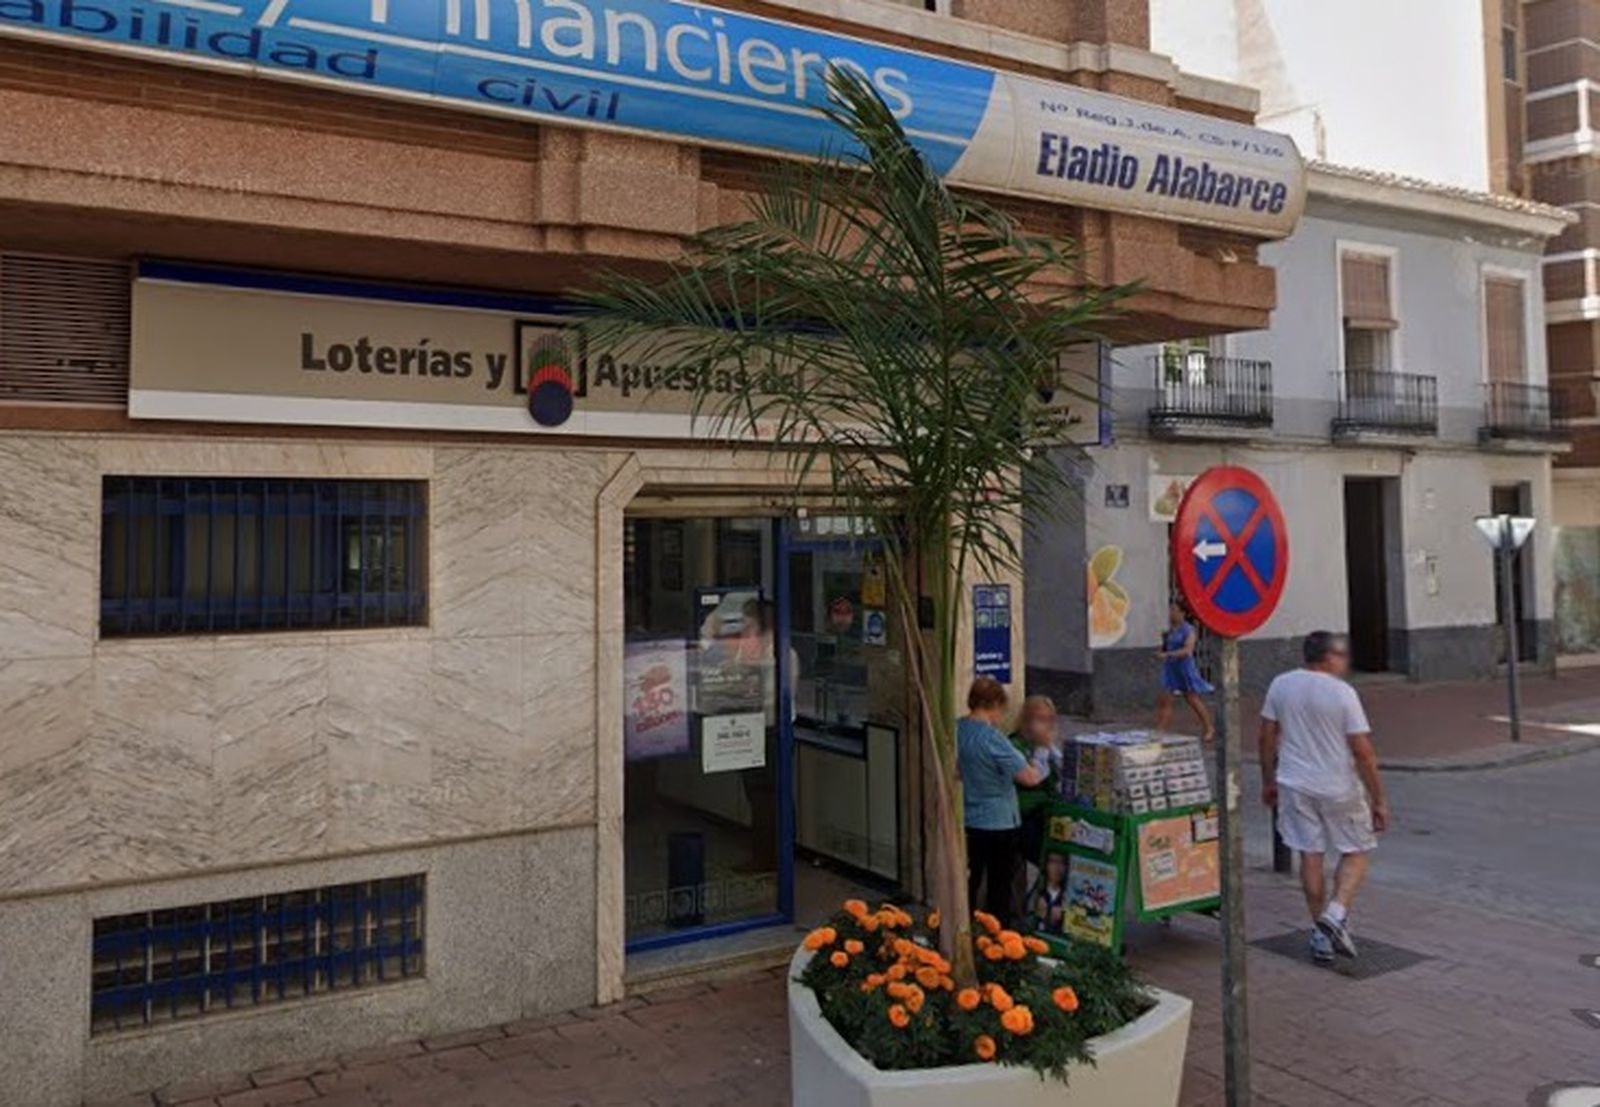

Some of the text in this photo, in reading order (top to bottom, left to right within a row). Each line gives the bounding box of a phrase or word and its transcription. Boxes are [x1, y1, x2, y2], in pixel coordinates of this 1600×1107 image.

[477, 78, 621, 121] civil
[1037, 132, 1288, 214] Eladio Alabarce
[301, 332, 472, 378] Loterías
[485, 353, 507, 390] y
[593, 352, 747, 397] Apuestas
